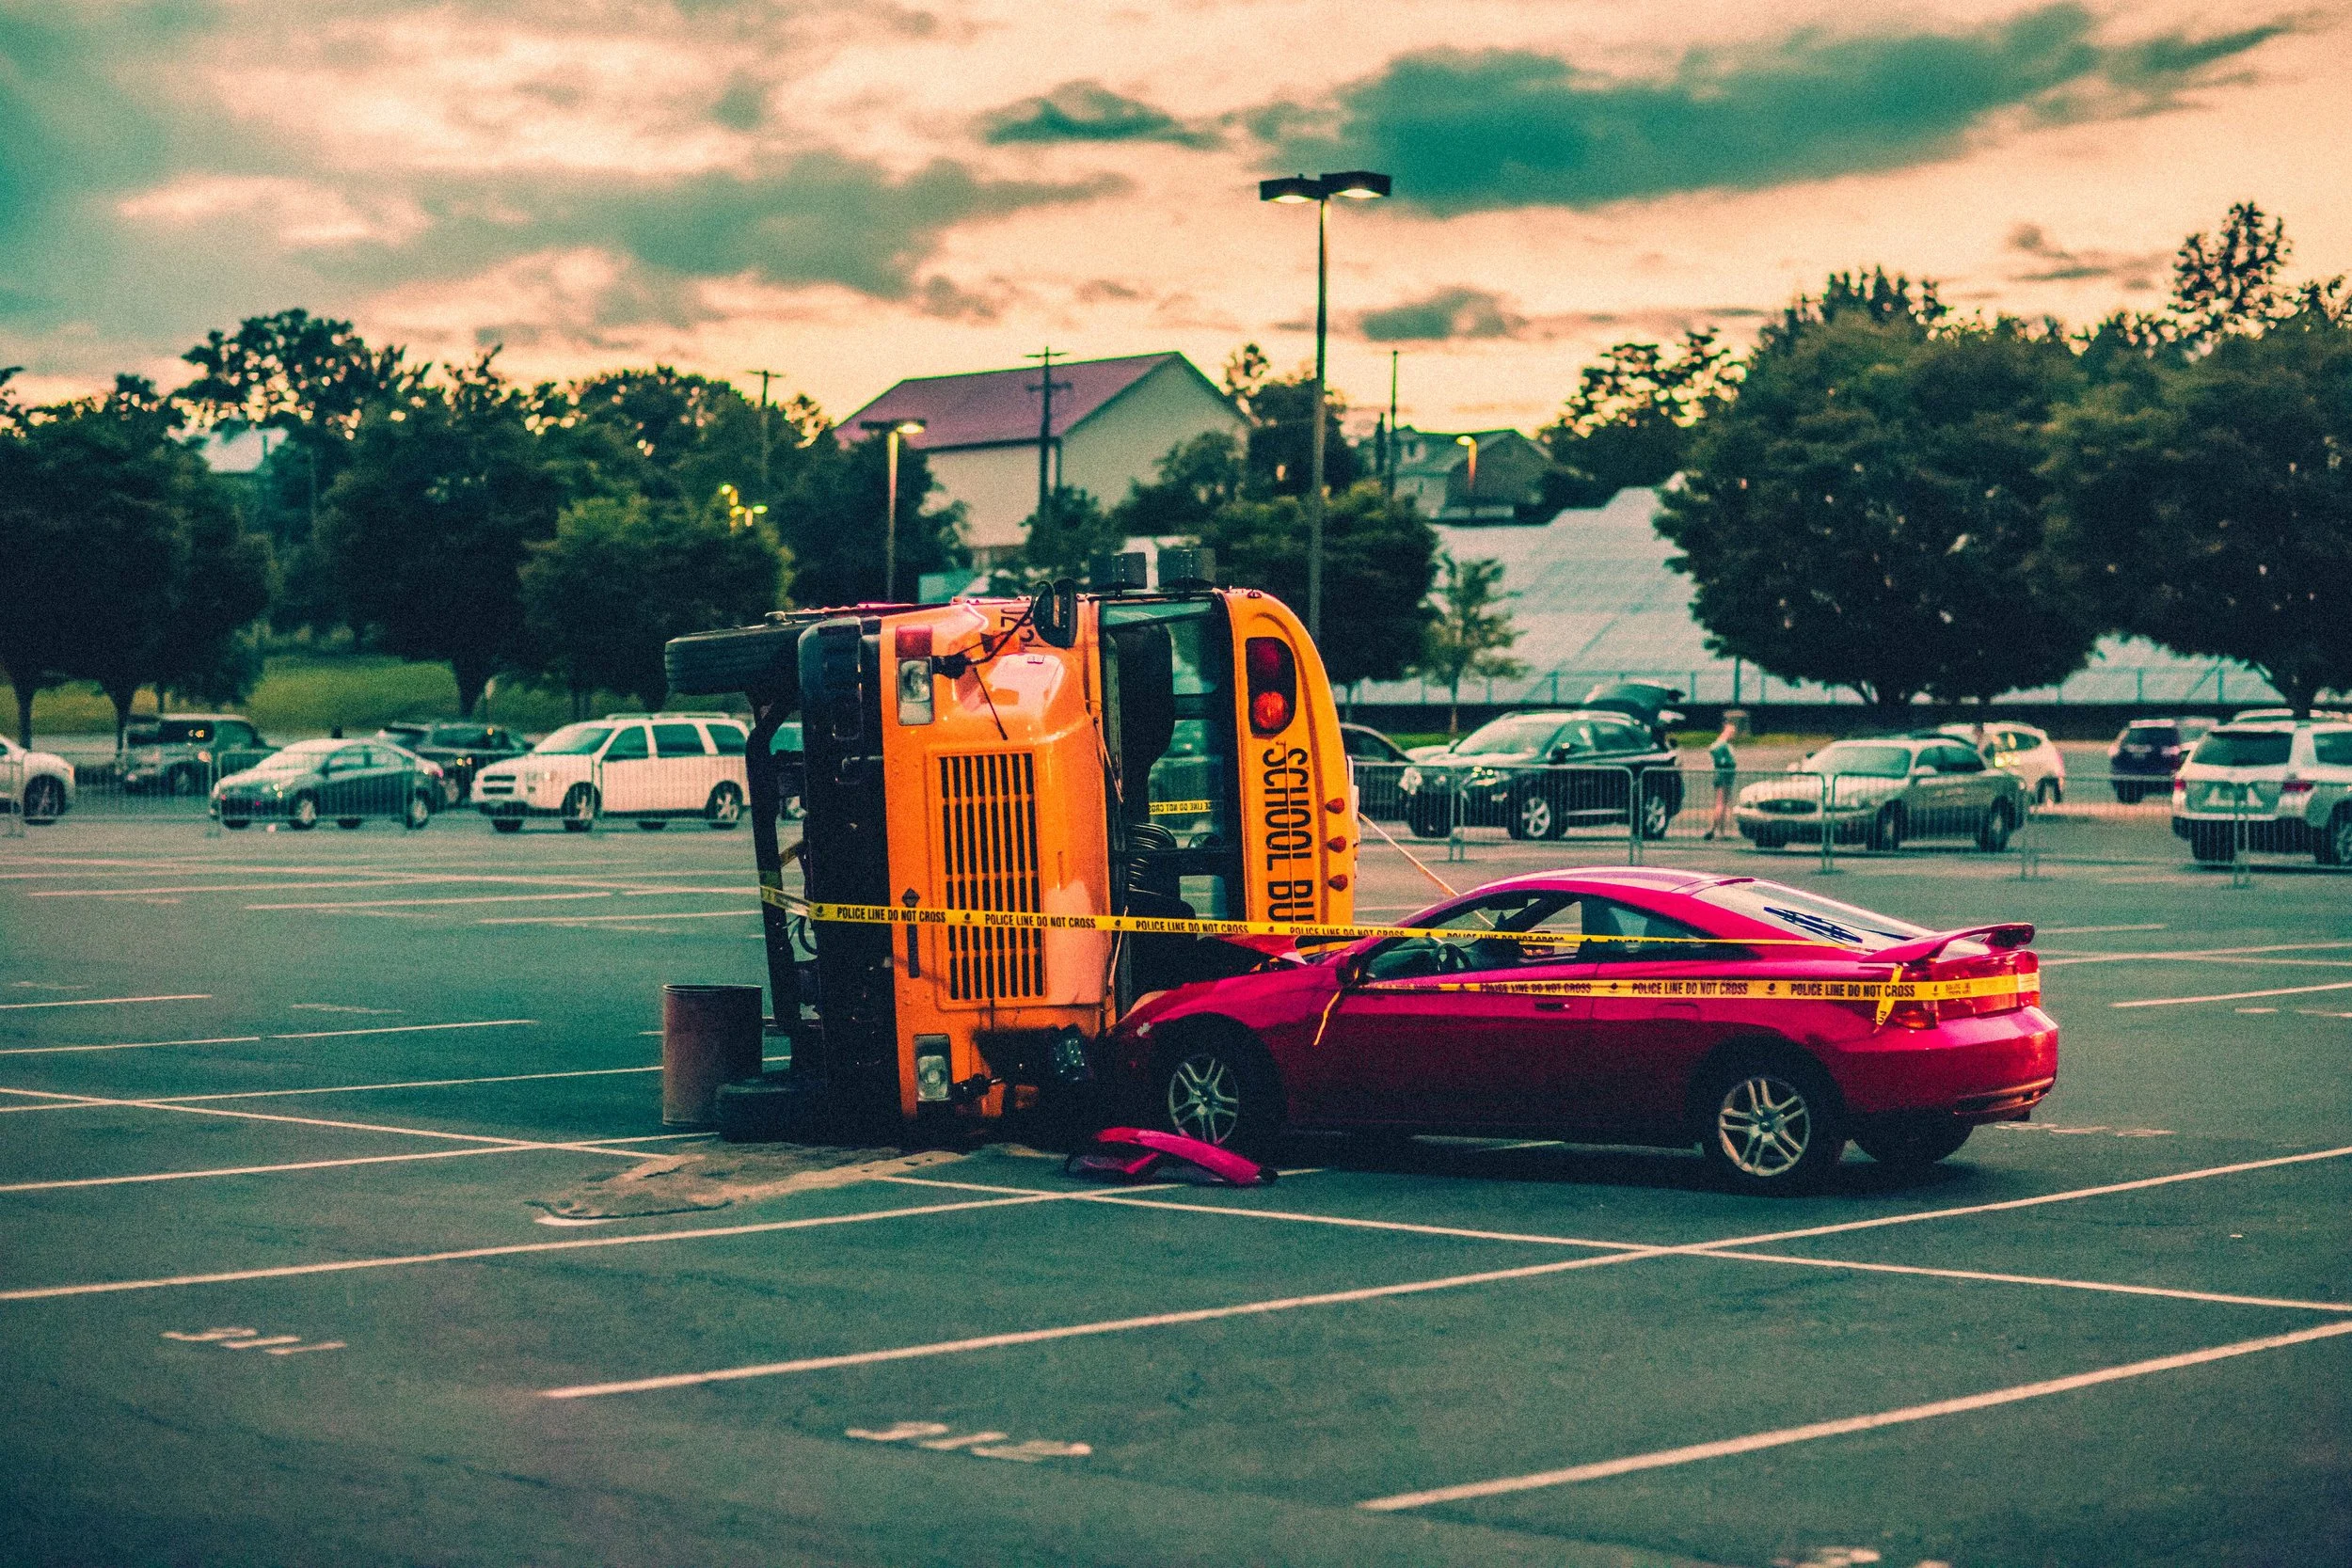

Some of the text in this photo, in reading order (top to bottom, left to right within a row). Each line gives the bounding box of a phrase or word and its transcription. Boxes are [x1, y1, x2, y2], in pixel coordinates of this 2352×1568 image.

[1263, 748, 1314, 923] SCHOOL BU
[836, 907, 946, 923] POLICE LINE DO NOT CROSS
[985, 913, 1096, 928] POLICE LINE DO NOT CROSS
[1136, 920, 1249, 933] POLICE LINE DO NOT CROSS
[1289, 927, 1319, 935] POLICE
[1480, 983, 1592, 993] POLICE LINE DO NOT CROSS
[1632, 983, 1748, 995] POLICE LINE DO NOT CROSS
[1790, 983, 1915, 998] POLICE LINE DO NOT CROSS
